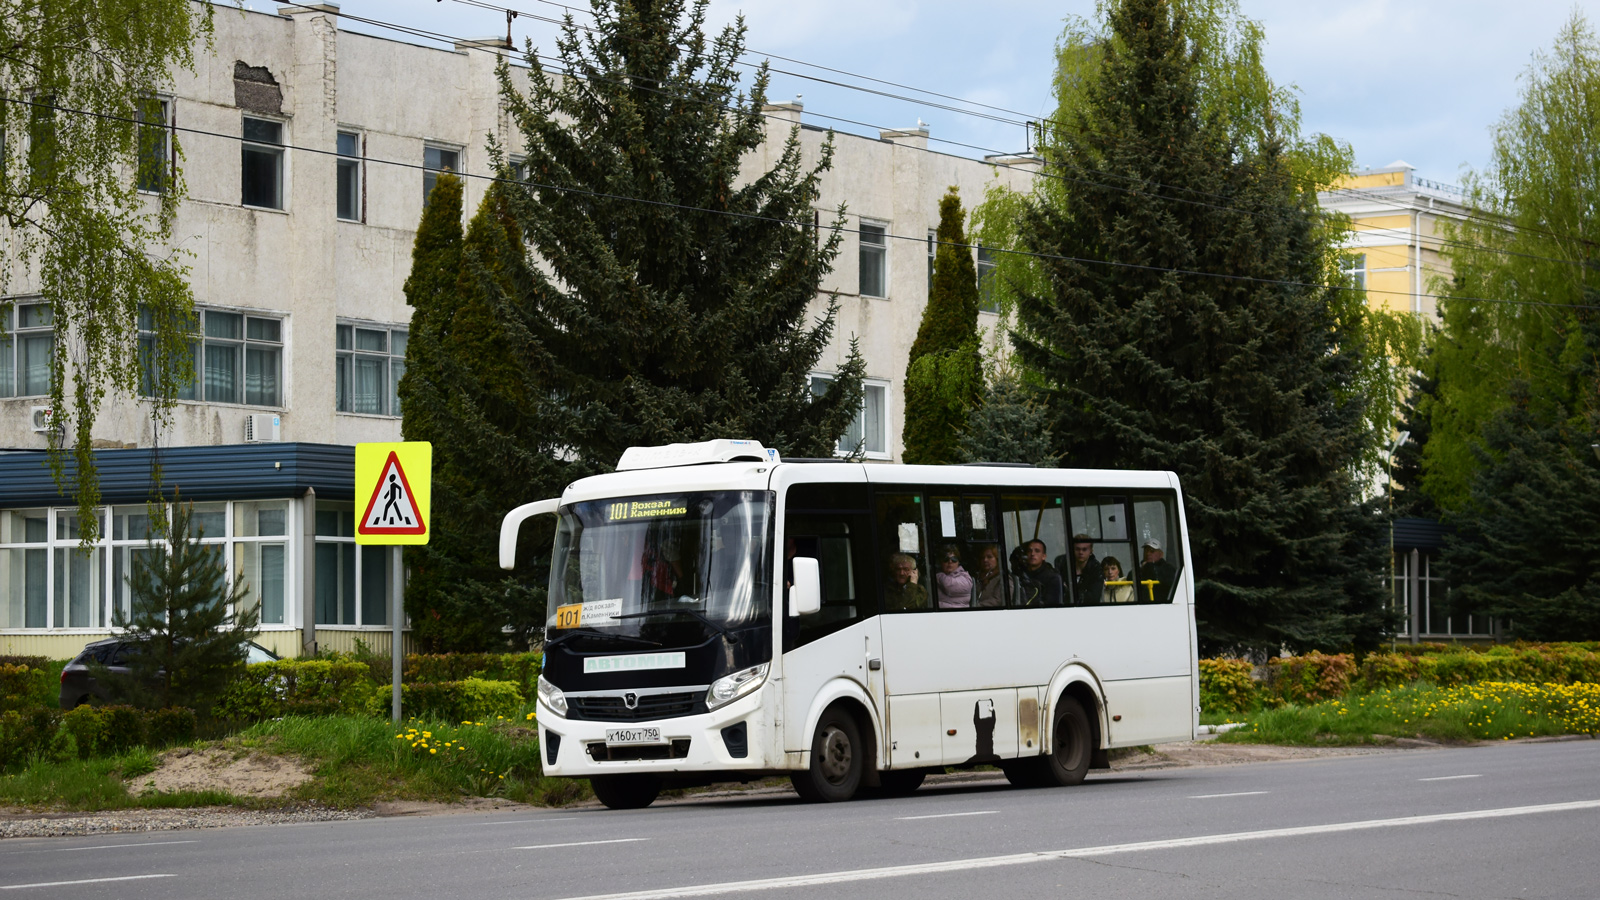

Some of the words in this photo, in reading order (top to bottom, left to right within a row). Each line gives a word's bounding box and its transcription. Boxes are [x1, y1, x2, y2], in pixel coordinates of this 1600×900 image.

[610, 503, 628, 520] 101
[631, 501, 671, 509] Вокзал
[559, 610, 579, 626] 101
[585, 654, 682, 670] АВТОМИГ
